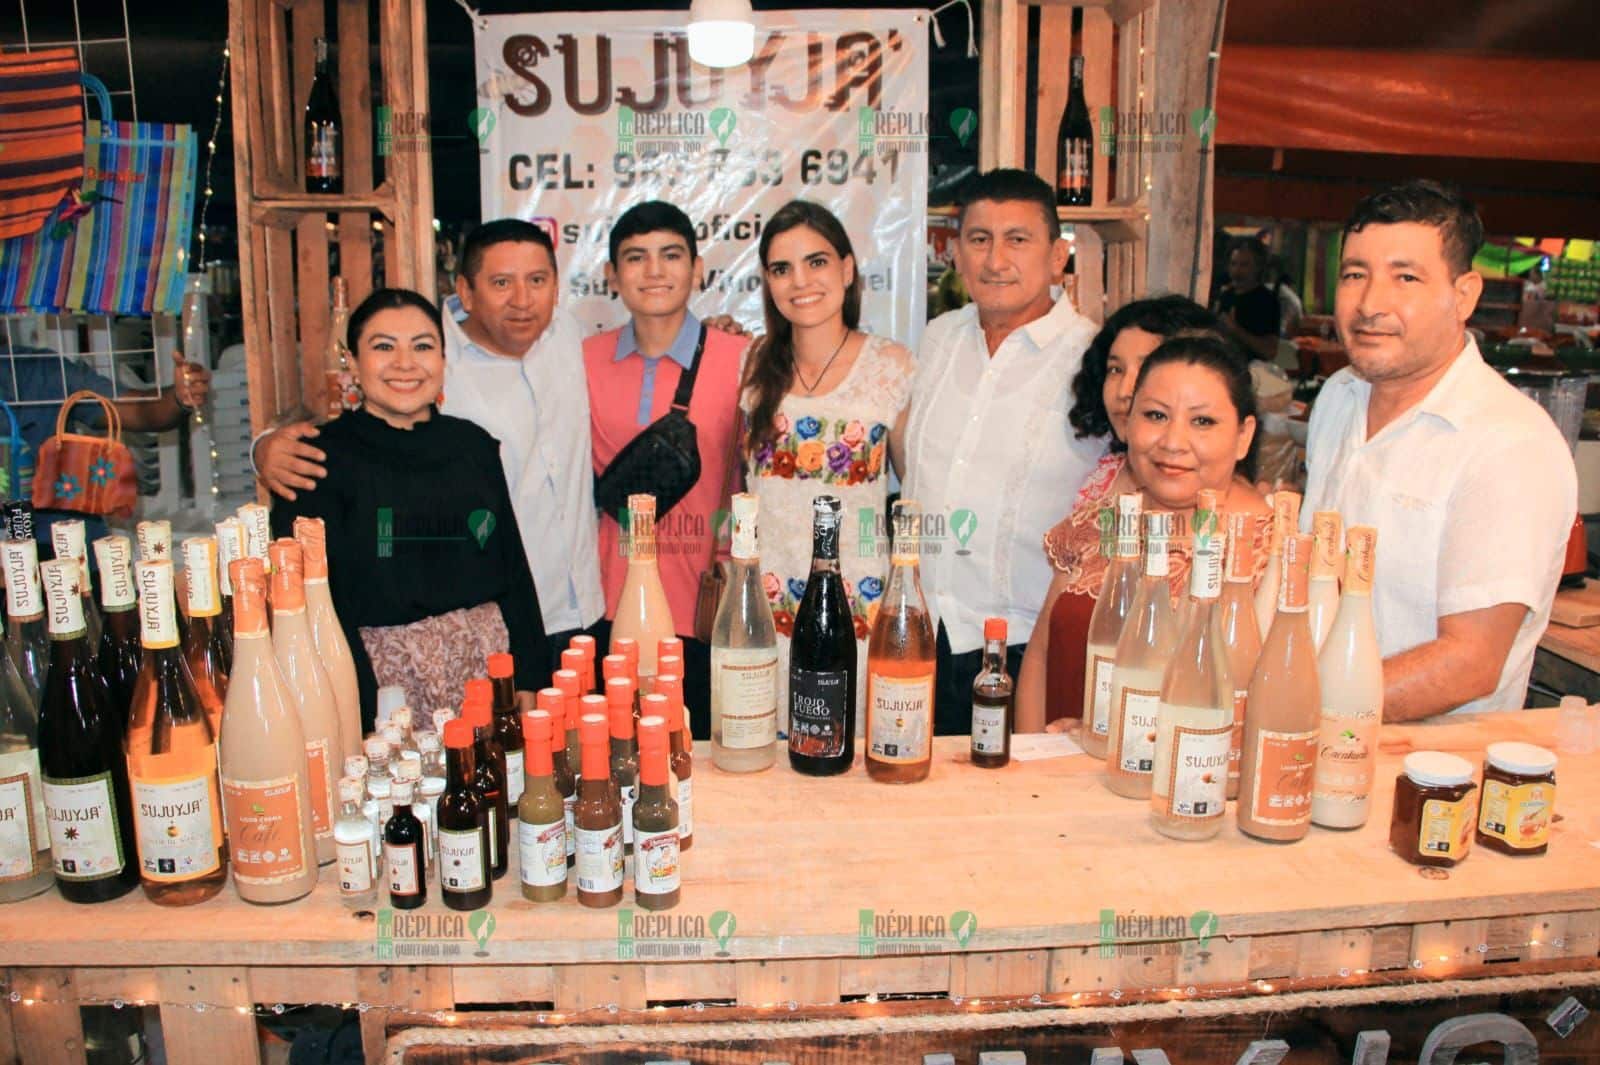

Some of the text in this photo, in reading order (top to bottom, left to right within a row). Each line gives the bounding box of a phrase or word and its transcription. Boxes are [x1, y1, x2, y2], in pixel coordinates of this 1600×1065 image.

[509, 153, 596, 191] CEL:
[801, 149, 900, 186] 6941
[140, 799, 203, 818] SUJUYJA'
